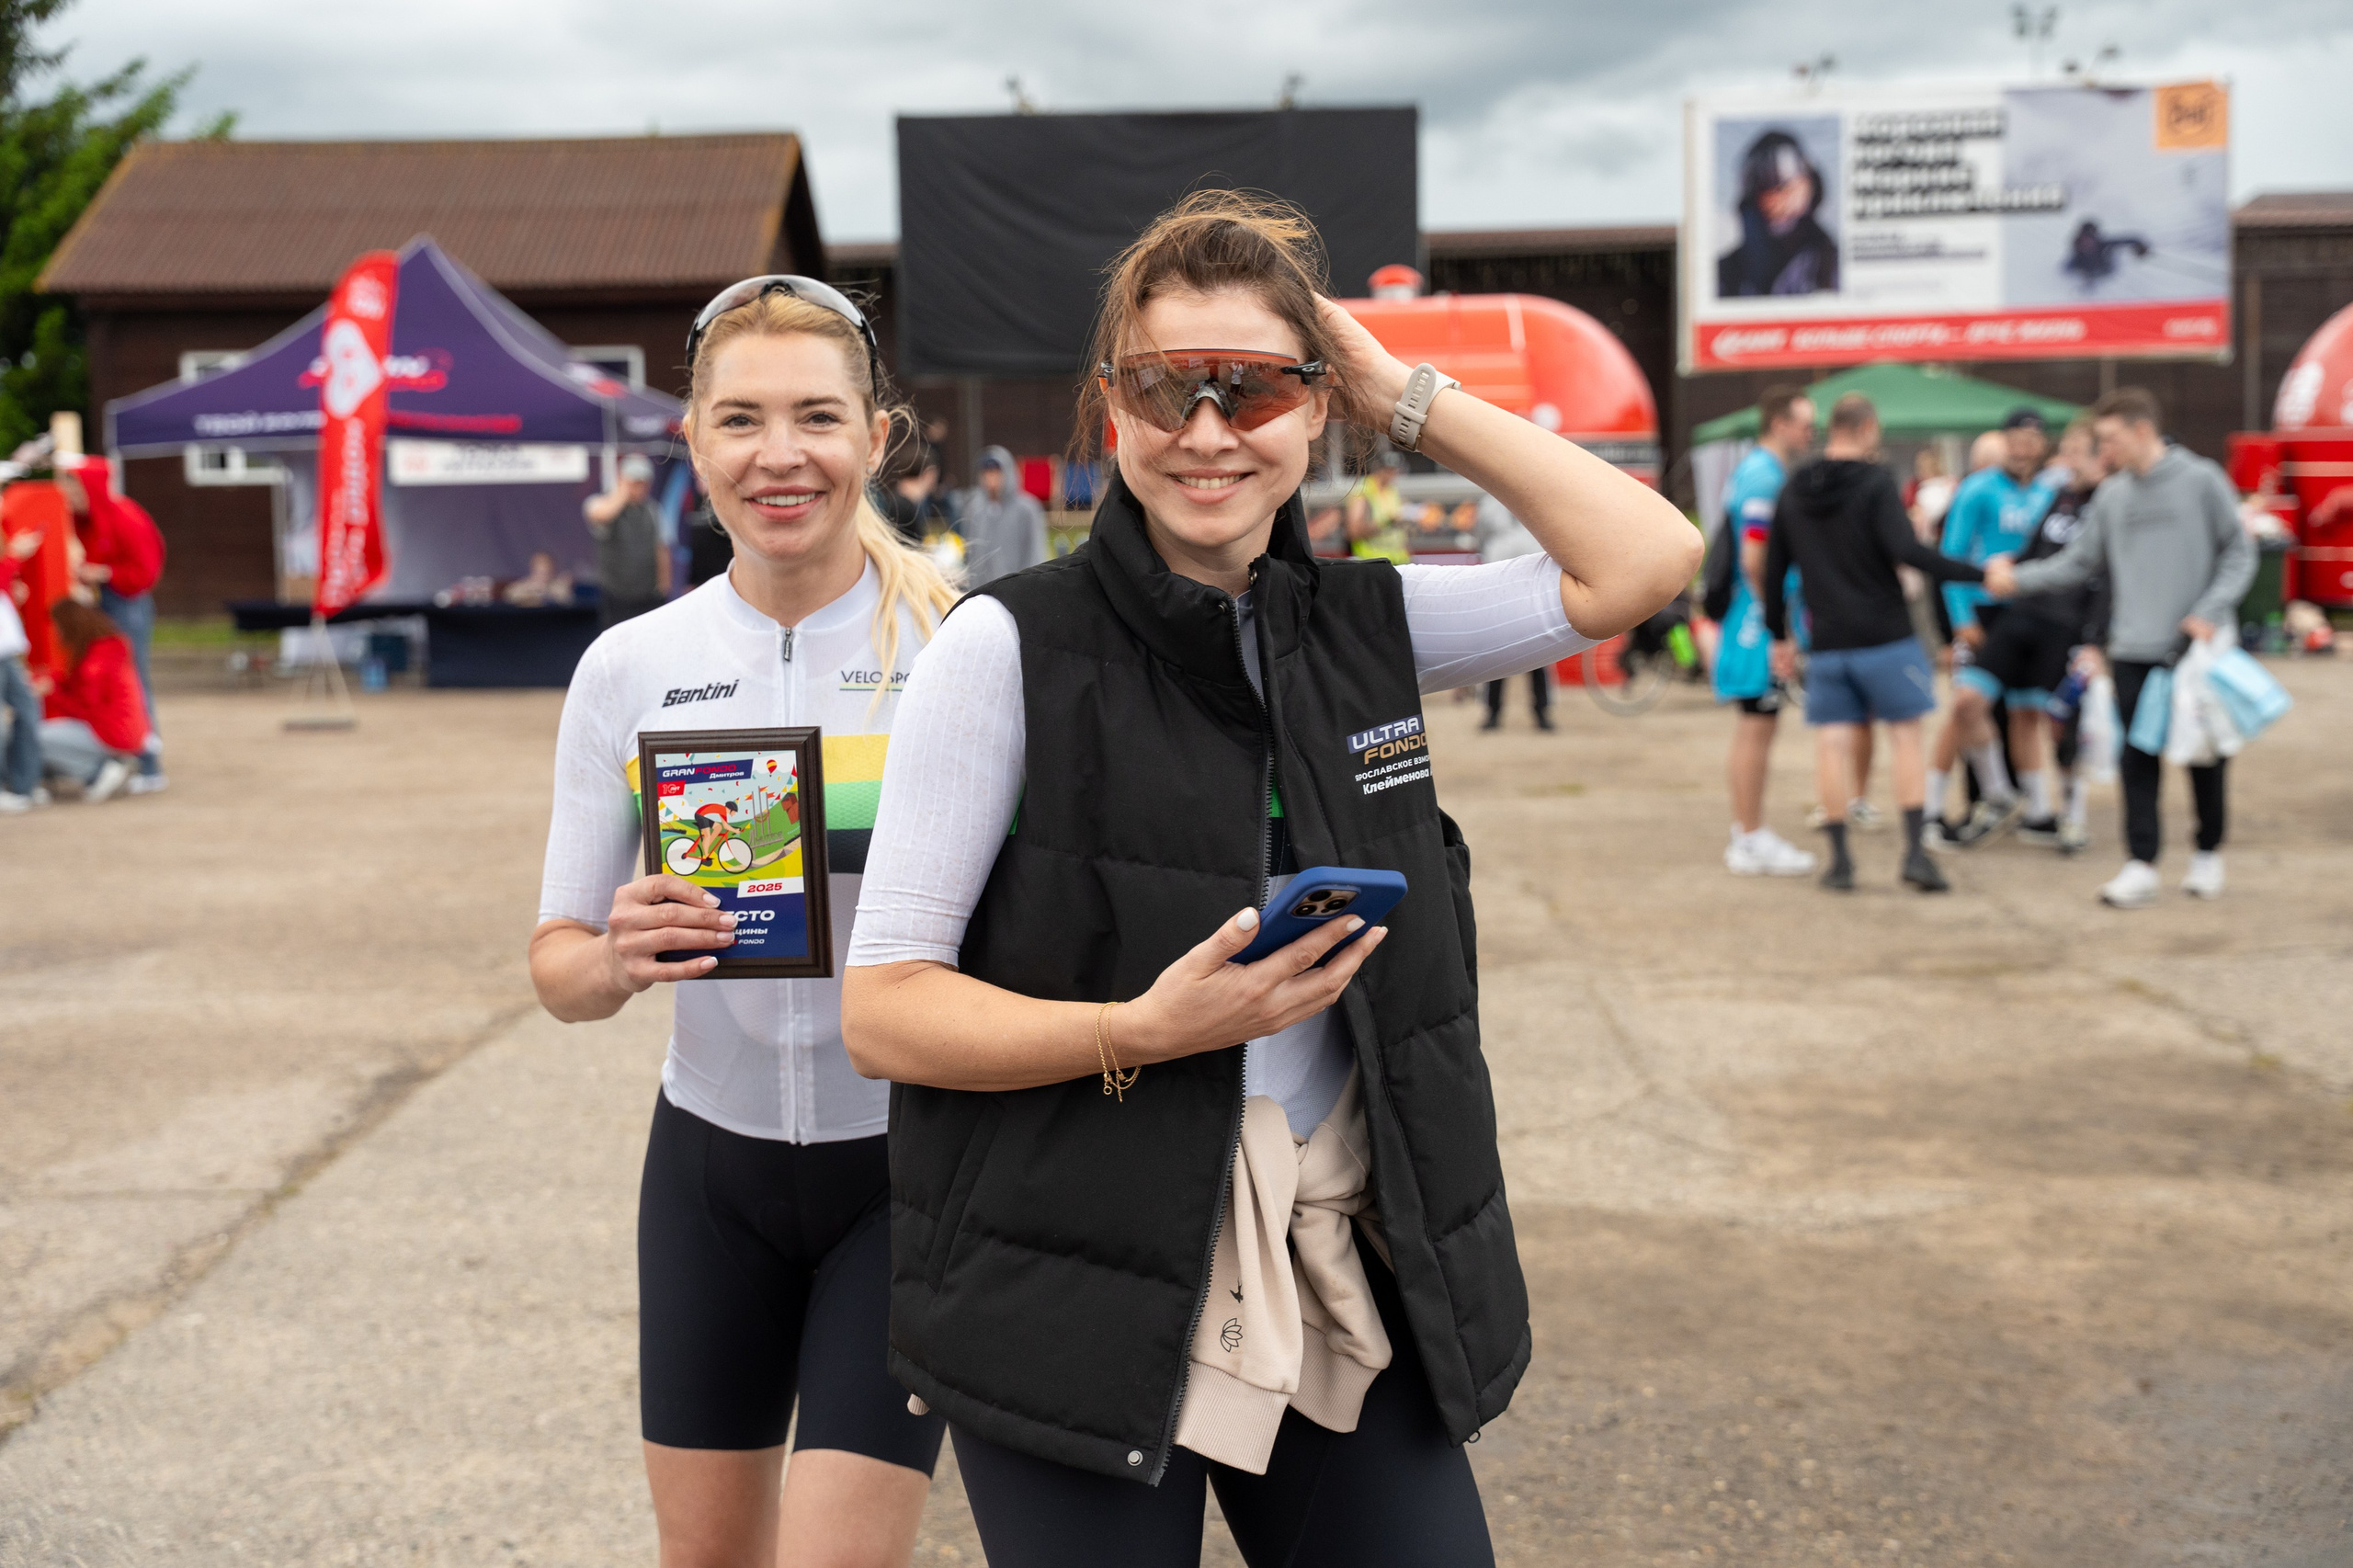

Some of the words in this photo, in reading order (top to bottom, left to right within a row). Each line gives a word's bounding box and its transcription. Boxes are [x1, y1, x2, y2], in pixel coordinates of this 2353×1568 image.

[662, 678, 739, 708] Santini
[1352, 717, 1420, 750] ULTRA
[709, 771, 745, 779] Дмитров
[1355, 759, 1413, 782] ЯРОСЛАВСКОЕ
[1362, 768, 1429, 795] Клейменова
[747, 882, 783, 893] 2025
